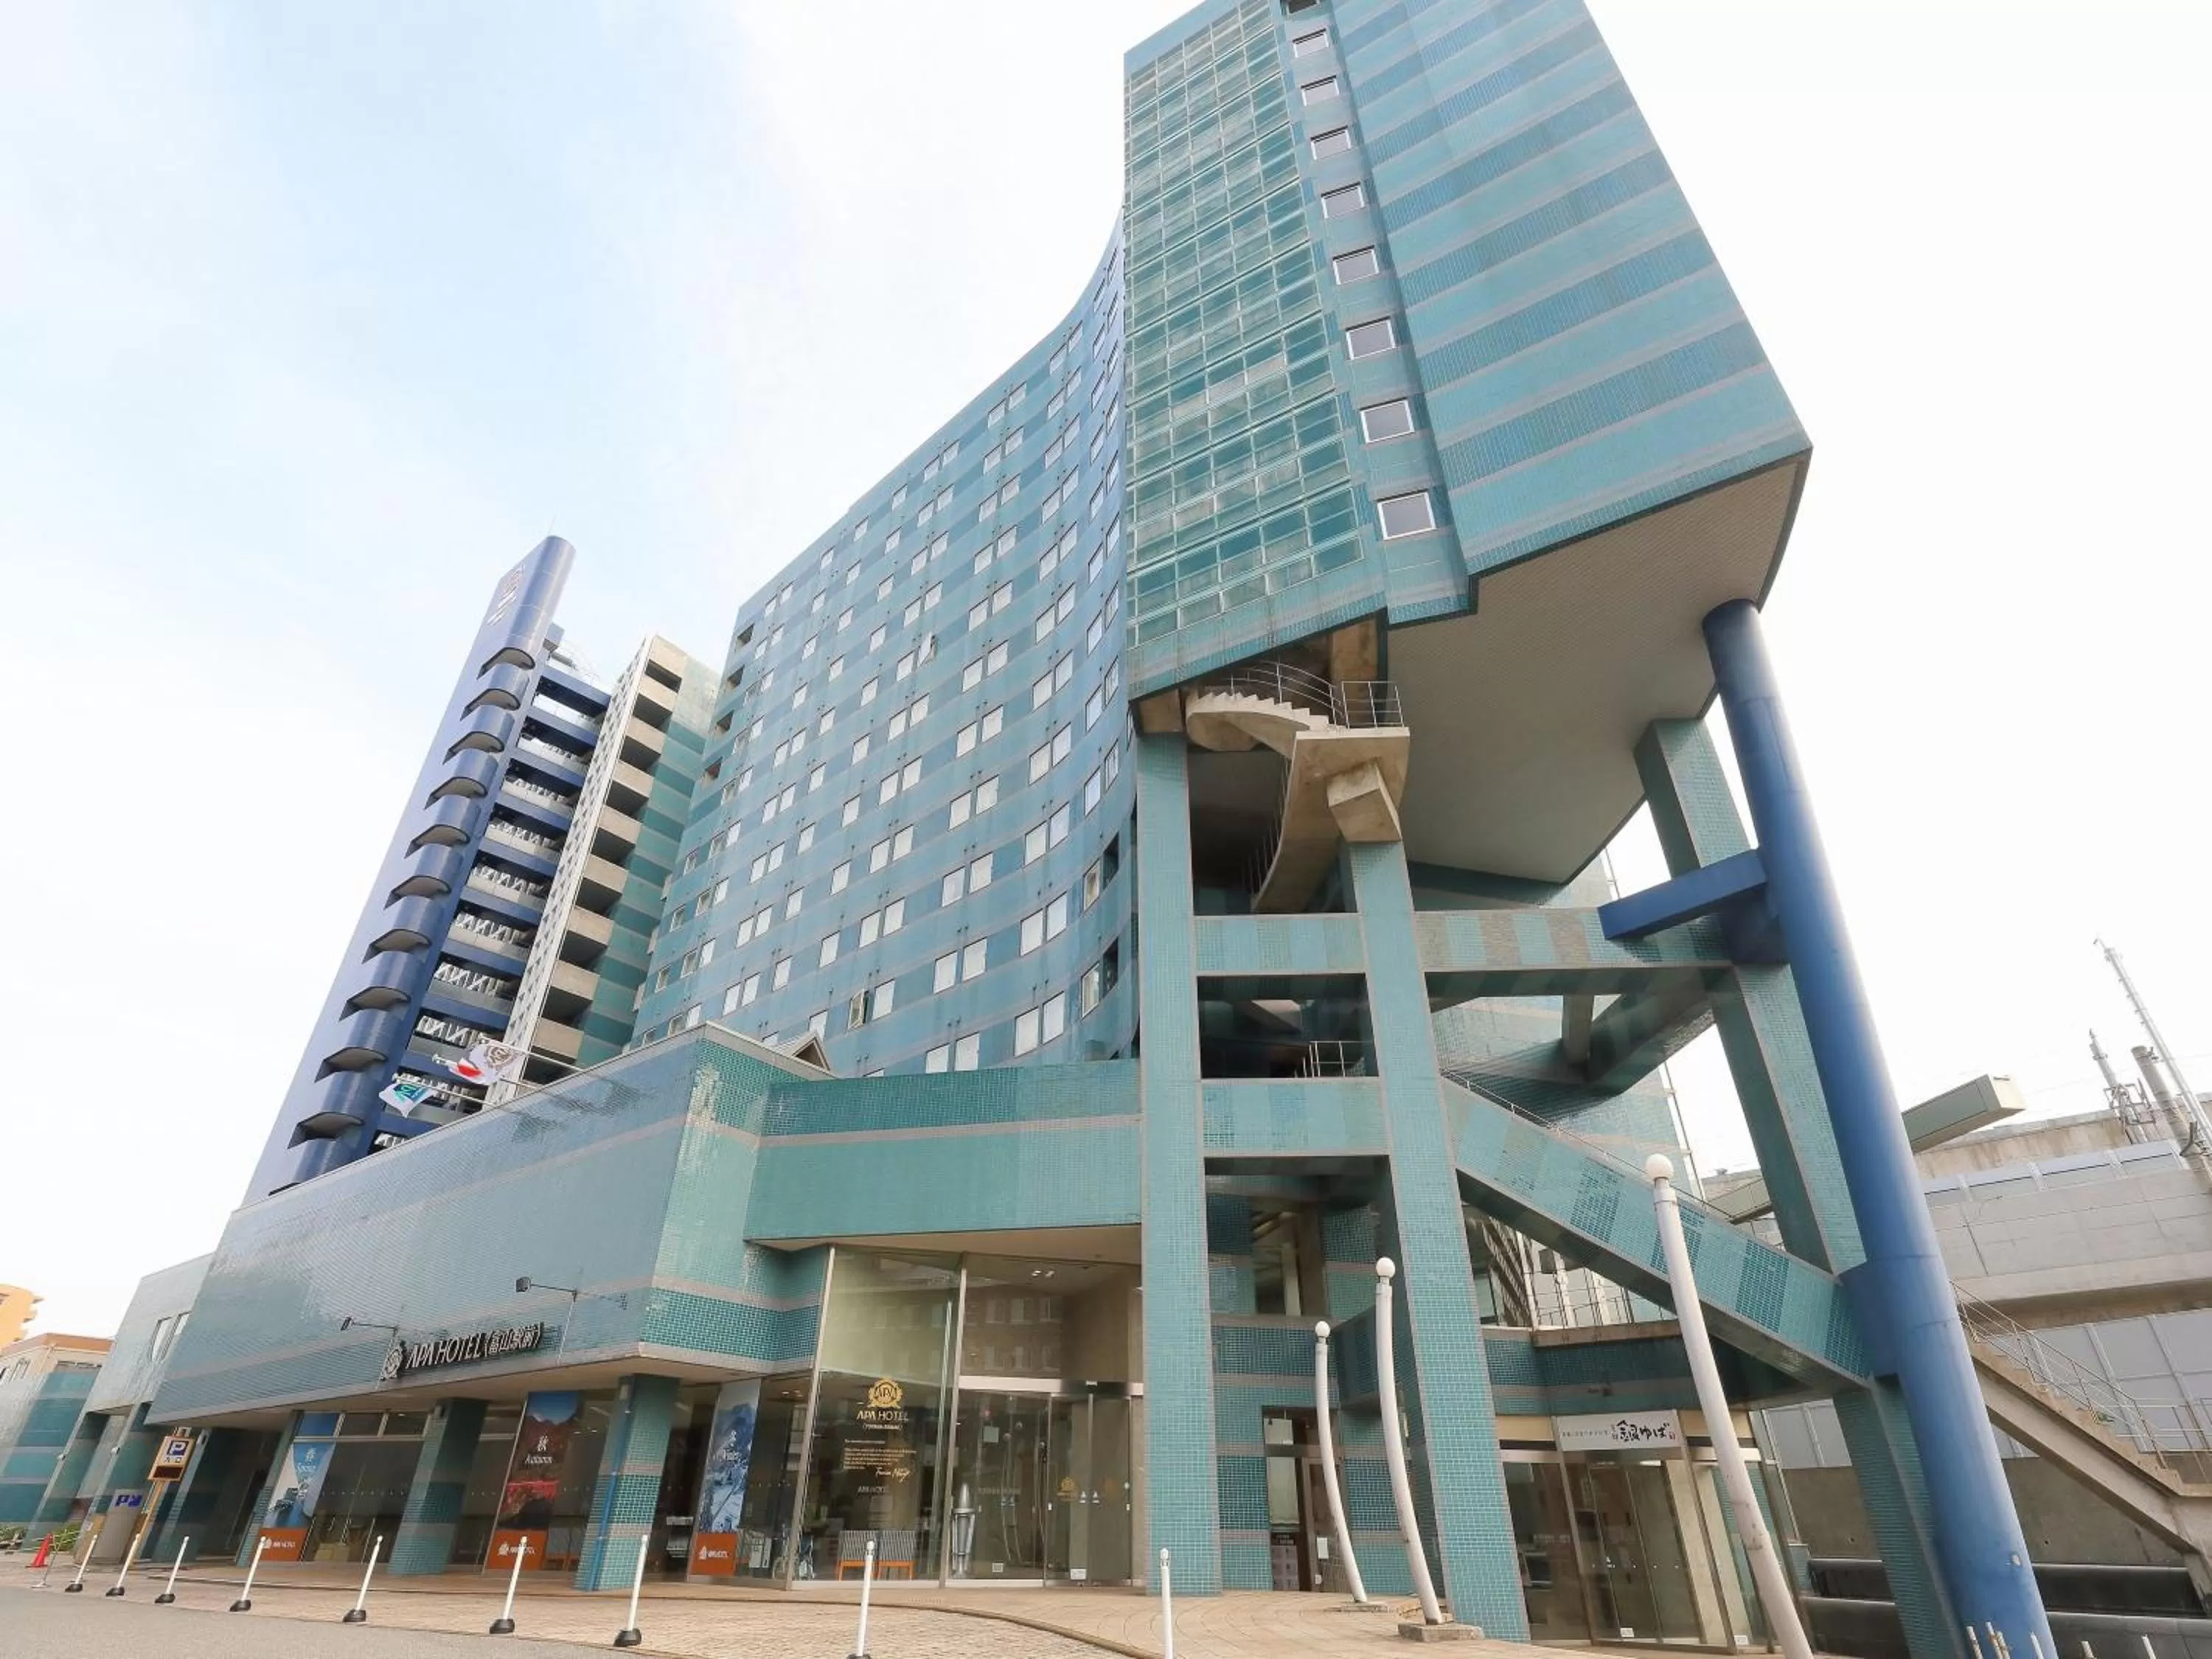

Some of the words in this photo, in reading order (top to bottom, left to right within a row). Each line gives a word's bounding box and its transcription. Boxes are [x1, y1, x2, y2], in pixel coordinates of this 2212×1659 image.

[406, 1342, 434, 1369] APA
[435, 1333, 481, 1365] HOTEL
[856, 1410, 876, 1421] APA
[879, 1410, 908, 1421] HOTEL
[169, 1441, 187, 1455] P
[524, 1453, 553, 1464] Autumn
